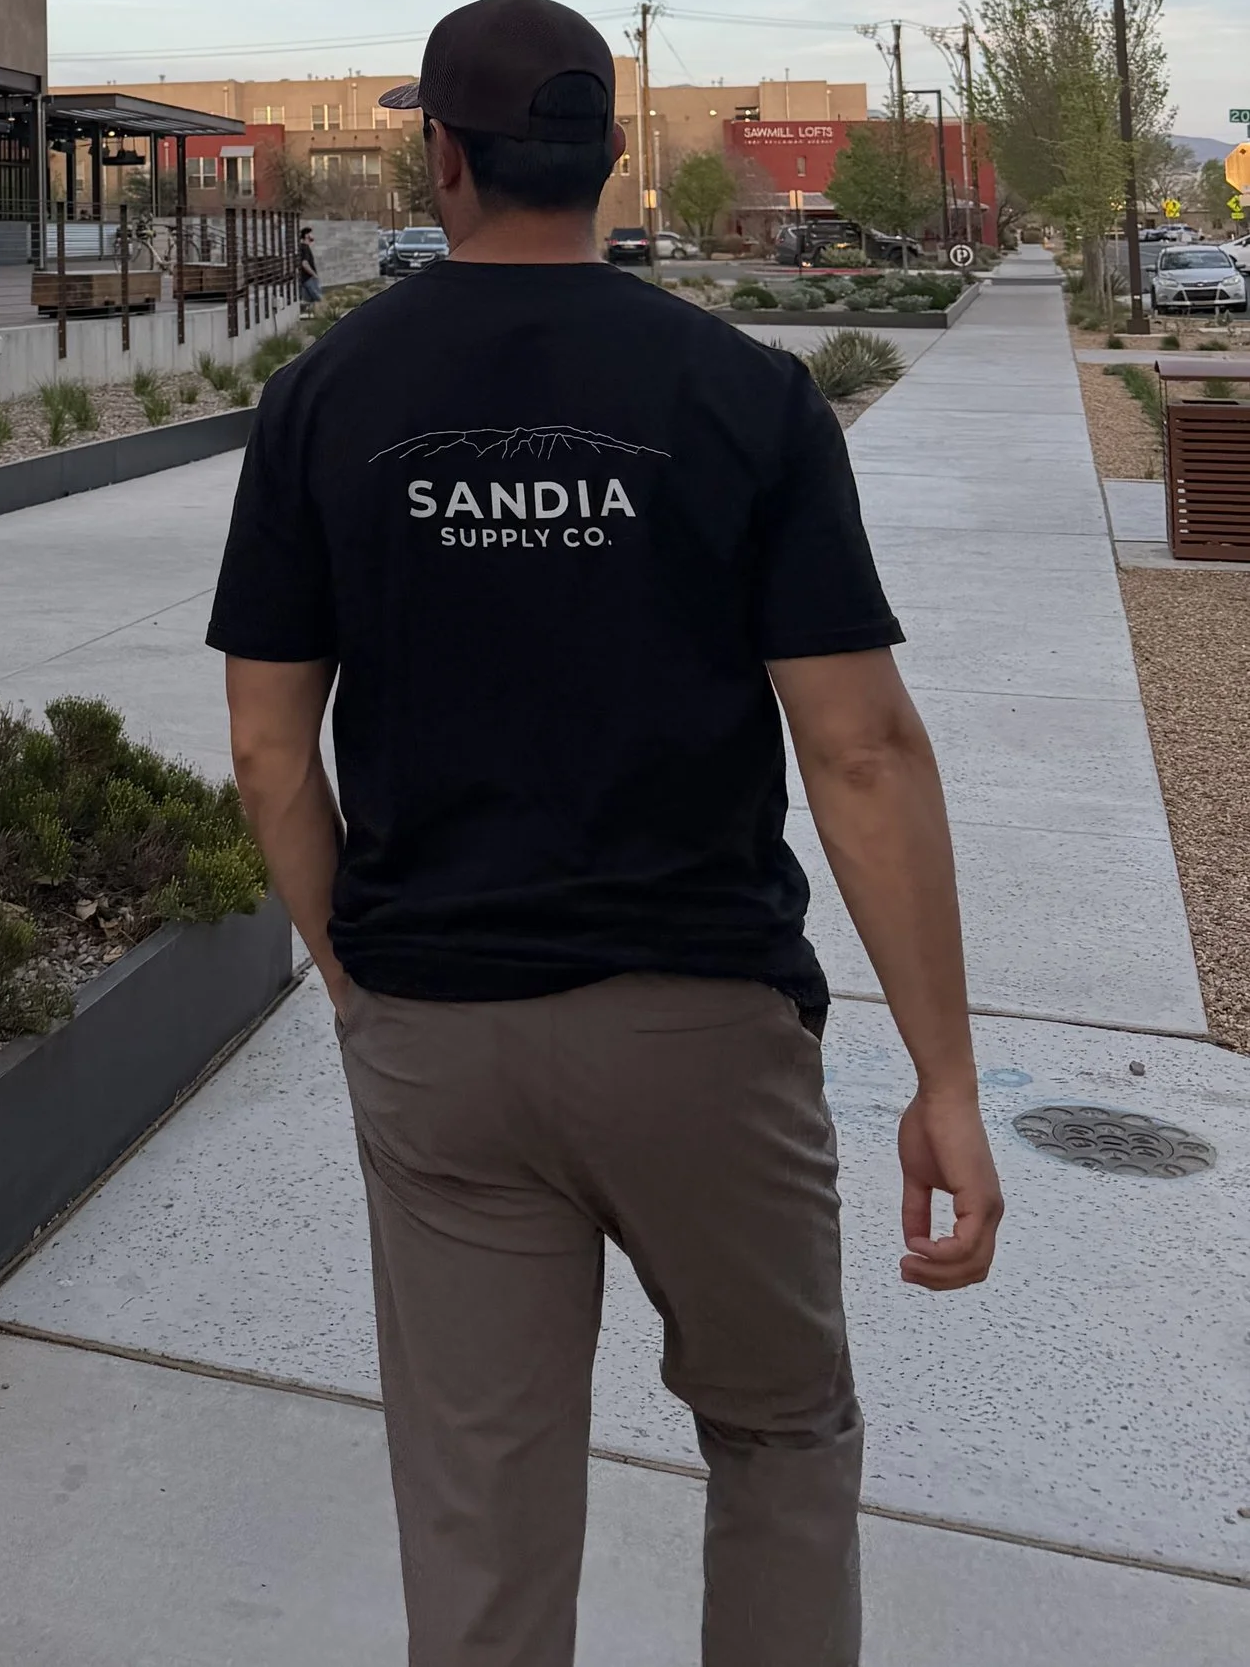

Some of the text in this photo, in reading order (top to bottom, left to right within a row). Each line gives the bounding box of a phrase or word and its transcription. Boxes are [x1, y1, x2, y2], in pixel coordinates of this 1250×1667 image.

[744, 127, 833, 138] SAWMILL LOFTS
[407, 478, 637, 520] SANDIA
[440, 527, 613, 548] SUPPLY CO.
